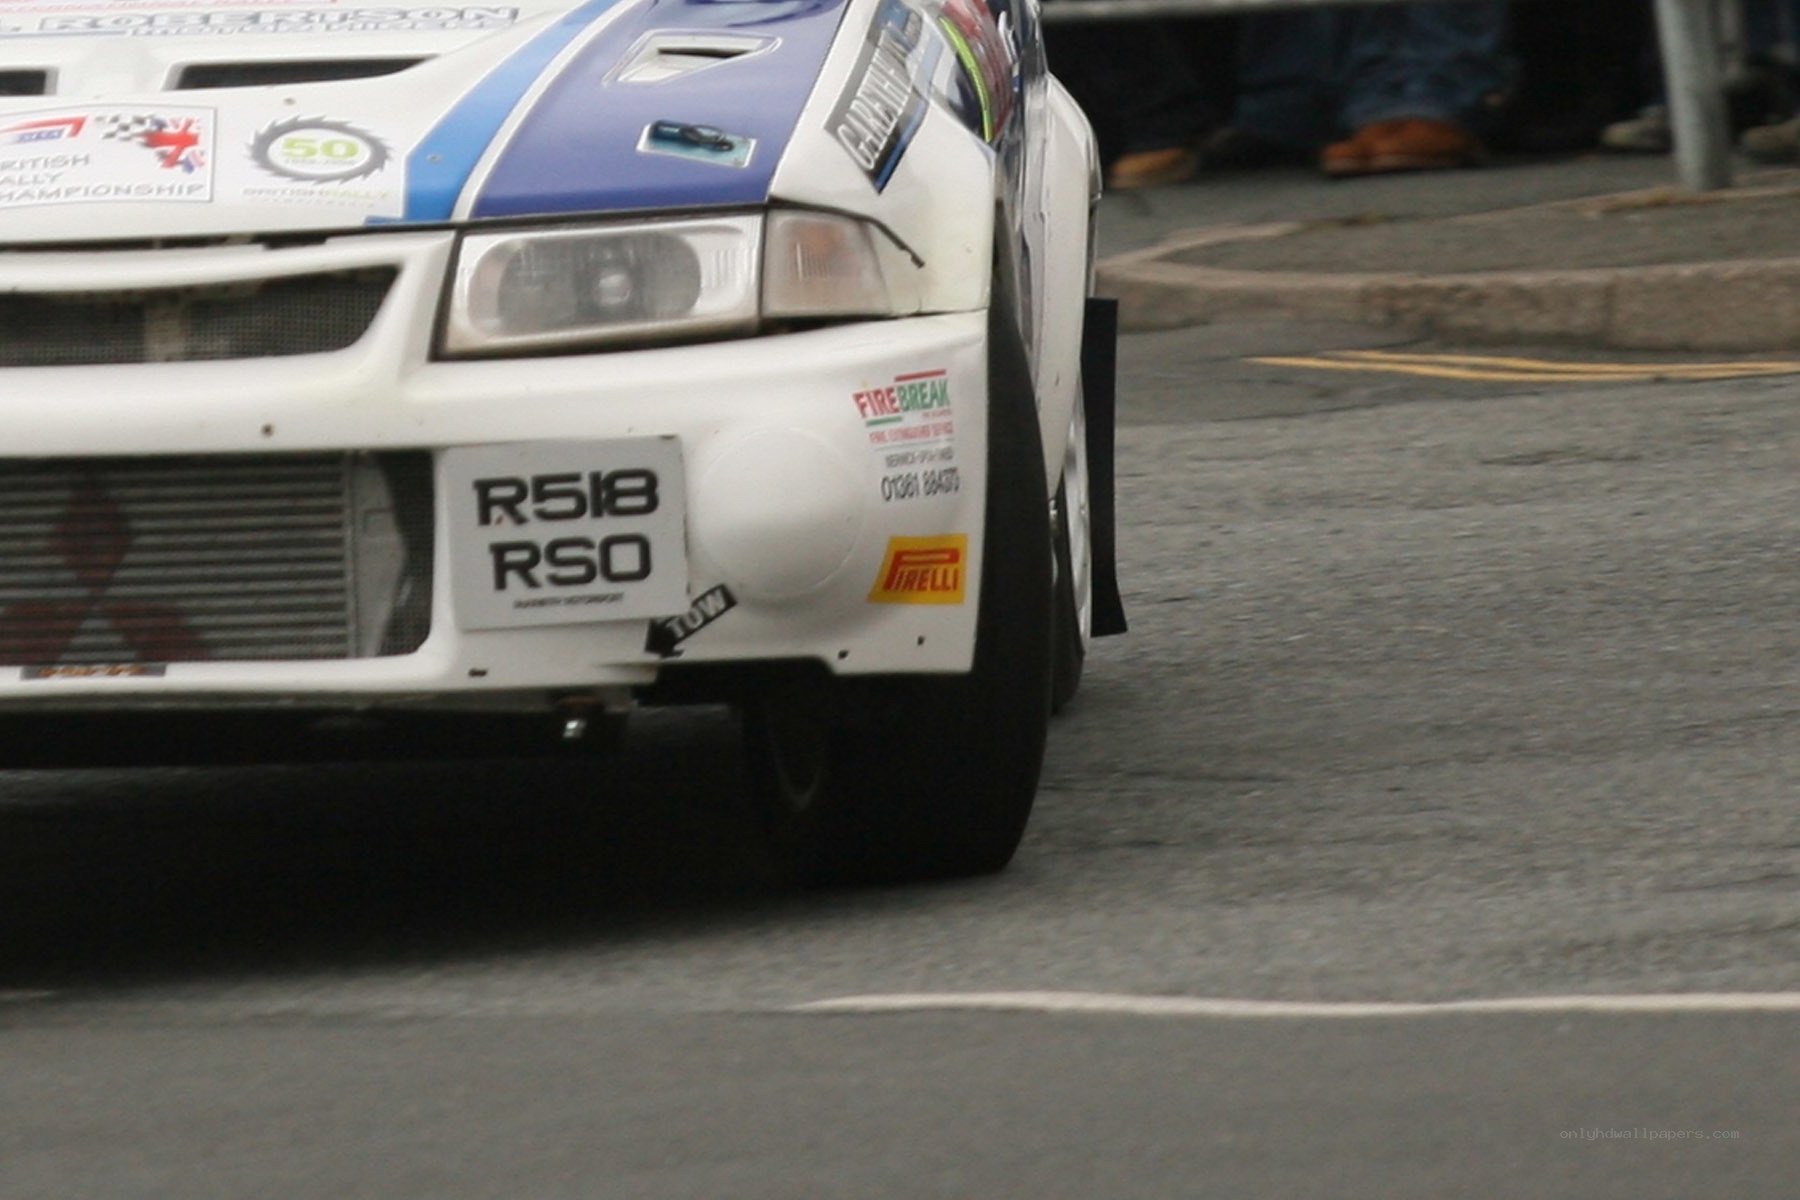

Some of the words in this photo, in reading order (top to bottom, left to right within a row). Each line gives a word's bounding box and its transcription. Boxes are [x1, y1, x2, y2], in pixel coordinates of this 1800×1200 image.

[38, 6, 520, 31] ROBERTSON
[281, 137, 360, 160] 50
[852, 379, 951, 418] FIREBREAK
[472, 467, 660, 527] R518
[488, 531, 653, 591] RSO
[882, 547, 961, 592] PIRELLI
[665, 585, 727, 639] TOW
